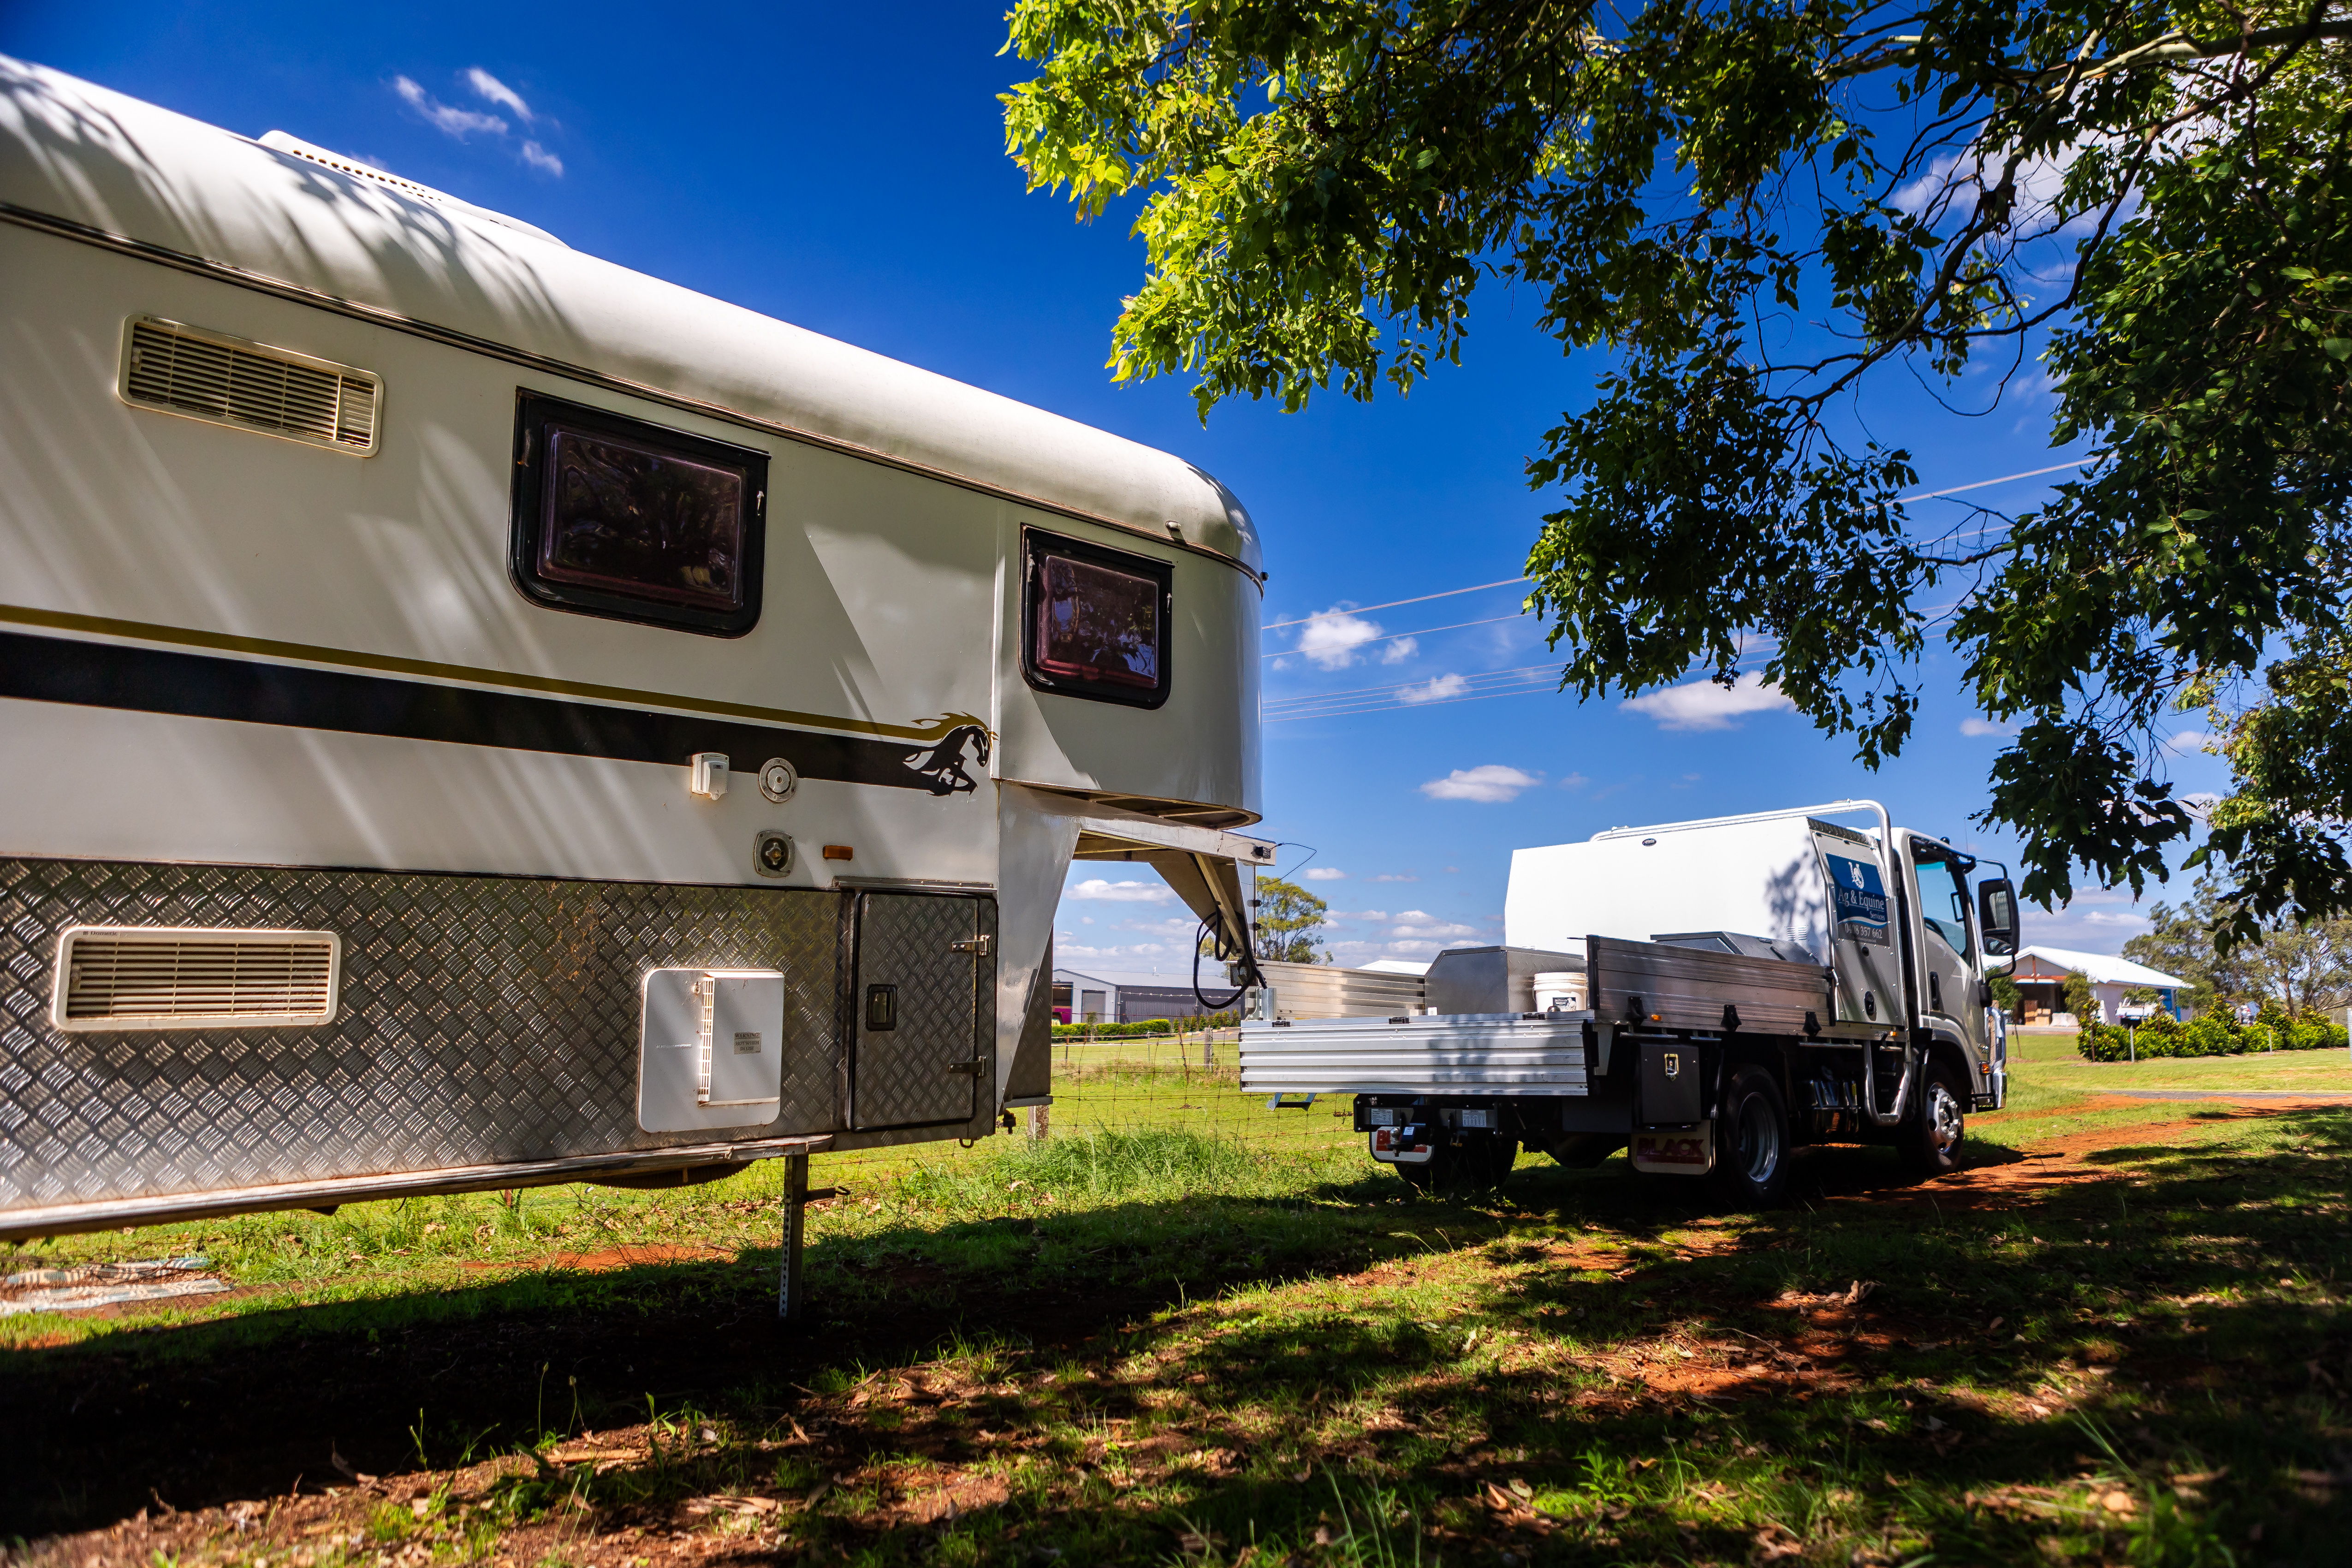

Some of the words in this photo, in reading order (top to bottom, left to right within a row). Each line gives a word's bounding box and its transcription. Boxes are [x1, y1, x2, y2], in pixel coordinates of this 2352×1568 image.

[1838, 887, 1849, 907] Ag
[1851, 890, 1857, 904] &
[1859, 891, 1884, 911] Equine
[1870, 911, 1885, 921] Services
[1860, 926, 1871, 937] 357
[1872, 928, 1883, 938] 662
[1637, 1137, 1705, 1156] BLACK
